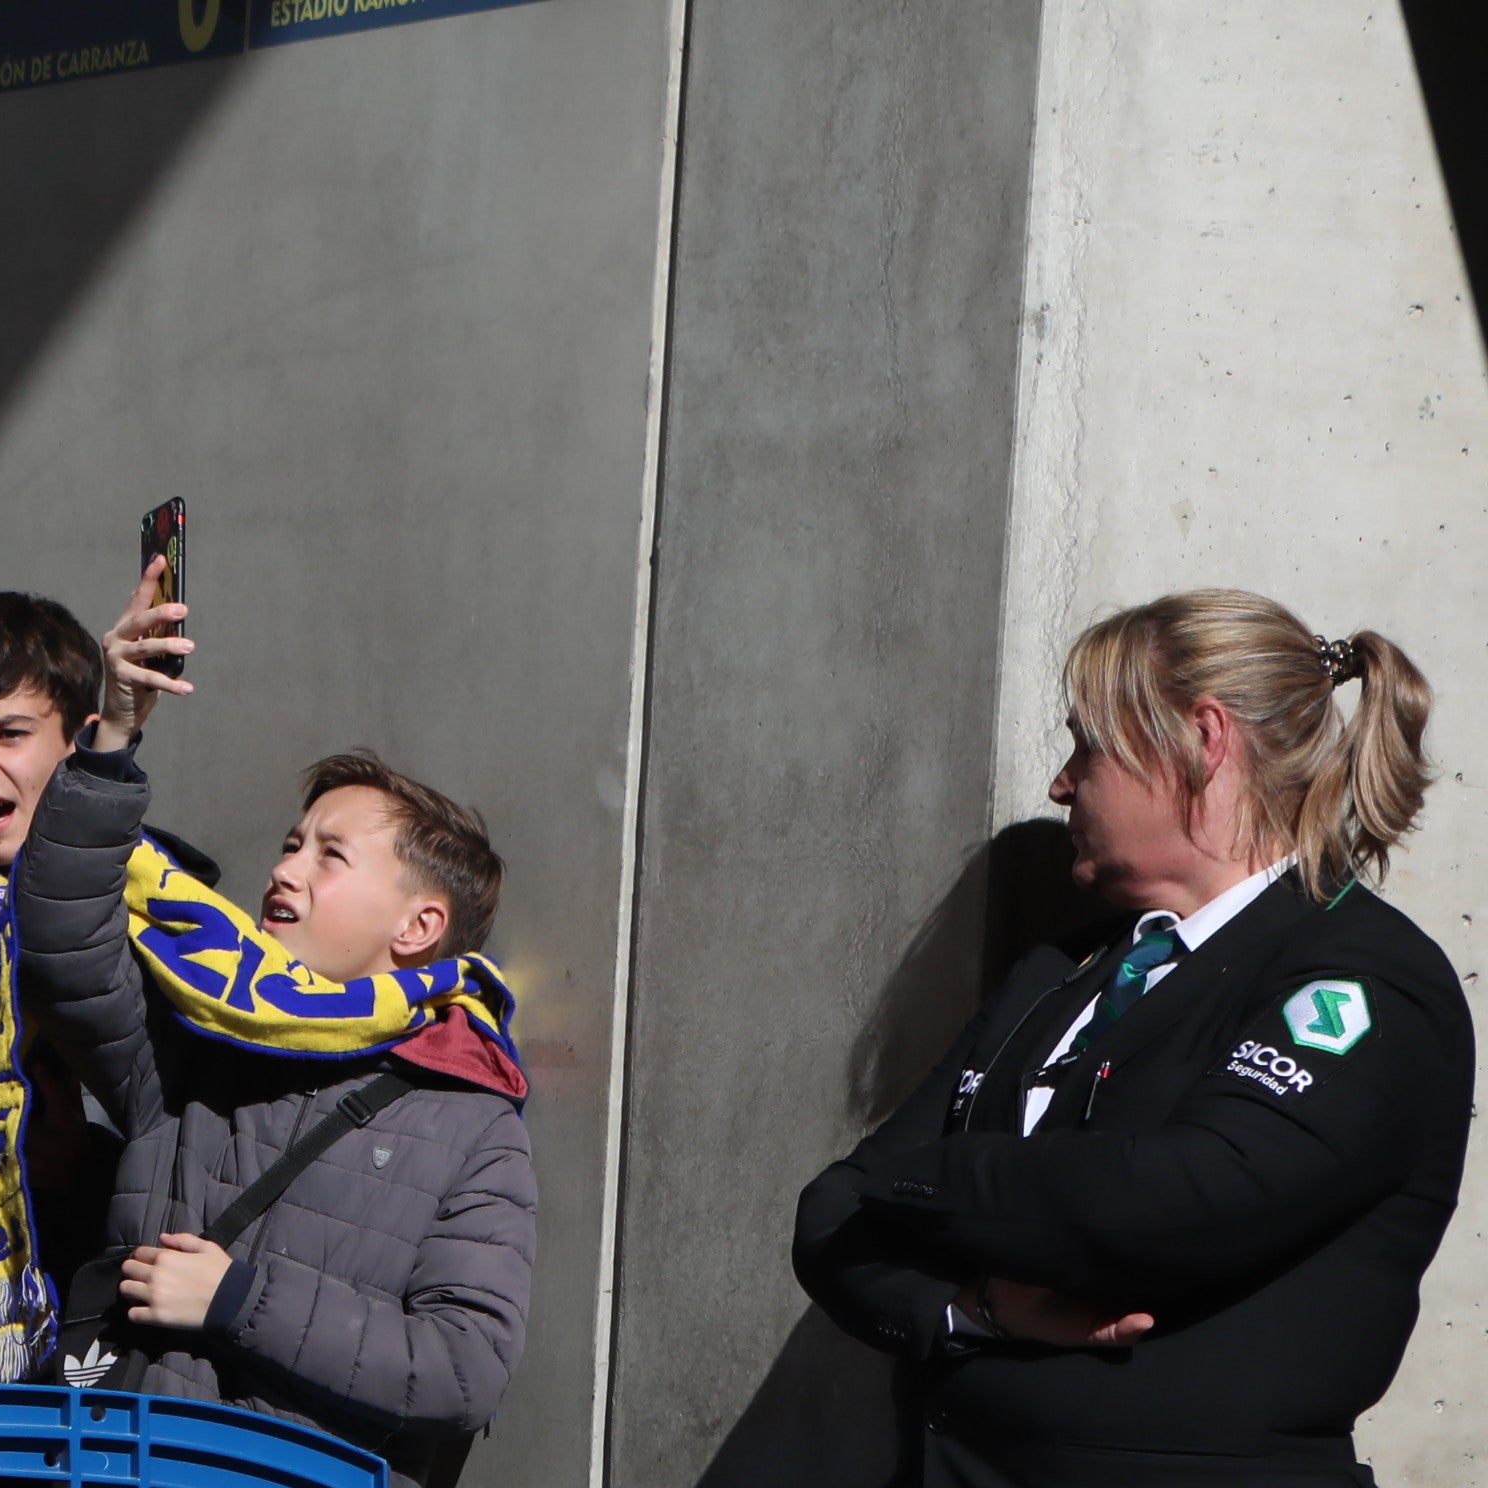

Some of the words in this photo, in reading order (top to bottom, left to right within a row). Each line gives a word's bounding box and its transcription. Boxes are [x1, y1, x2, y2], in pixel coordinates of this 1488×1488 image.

[31, 53, 52, 81] DE
[57, 40, 149, 78] CARRANZA
[1226, 1060, 1289, 1096] Seguridad
[1232, 1040, 1313, 1094] SICOR
